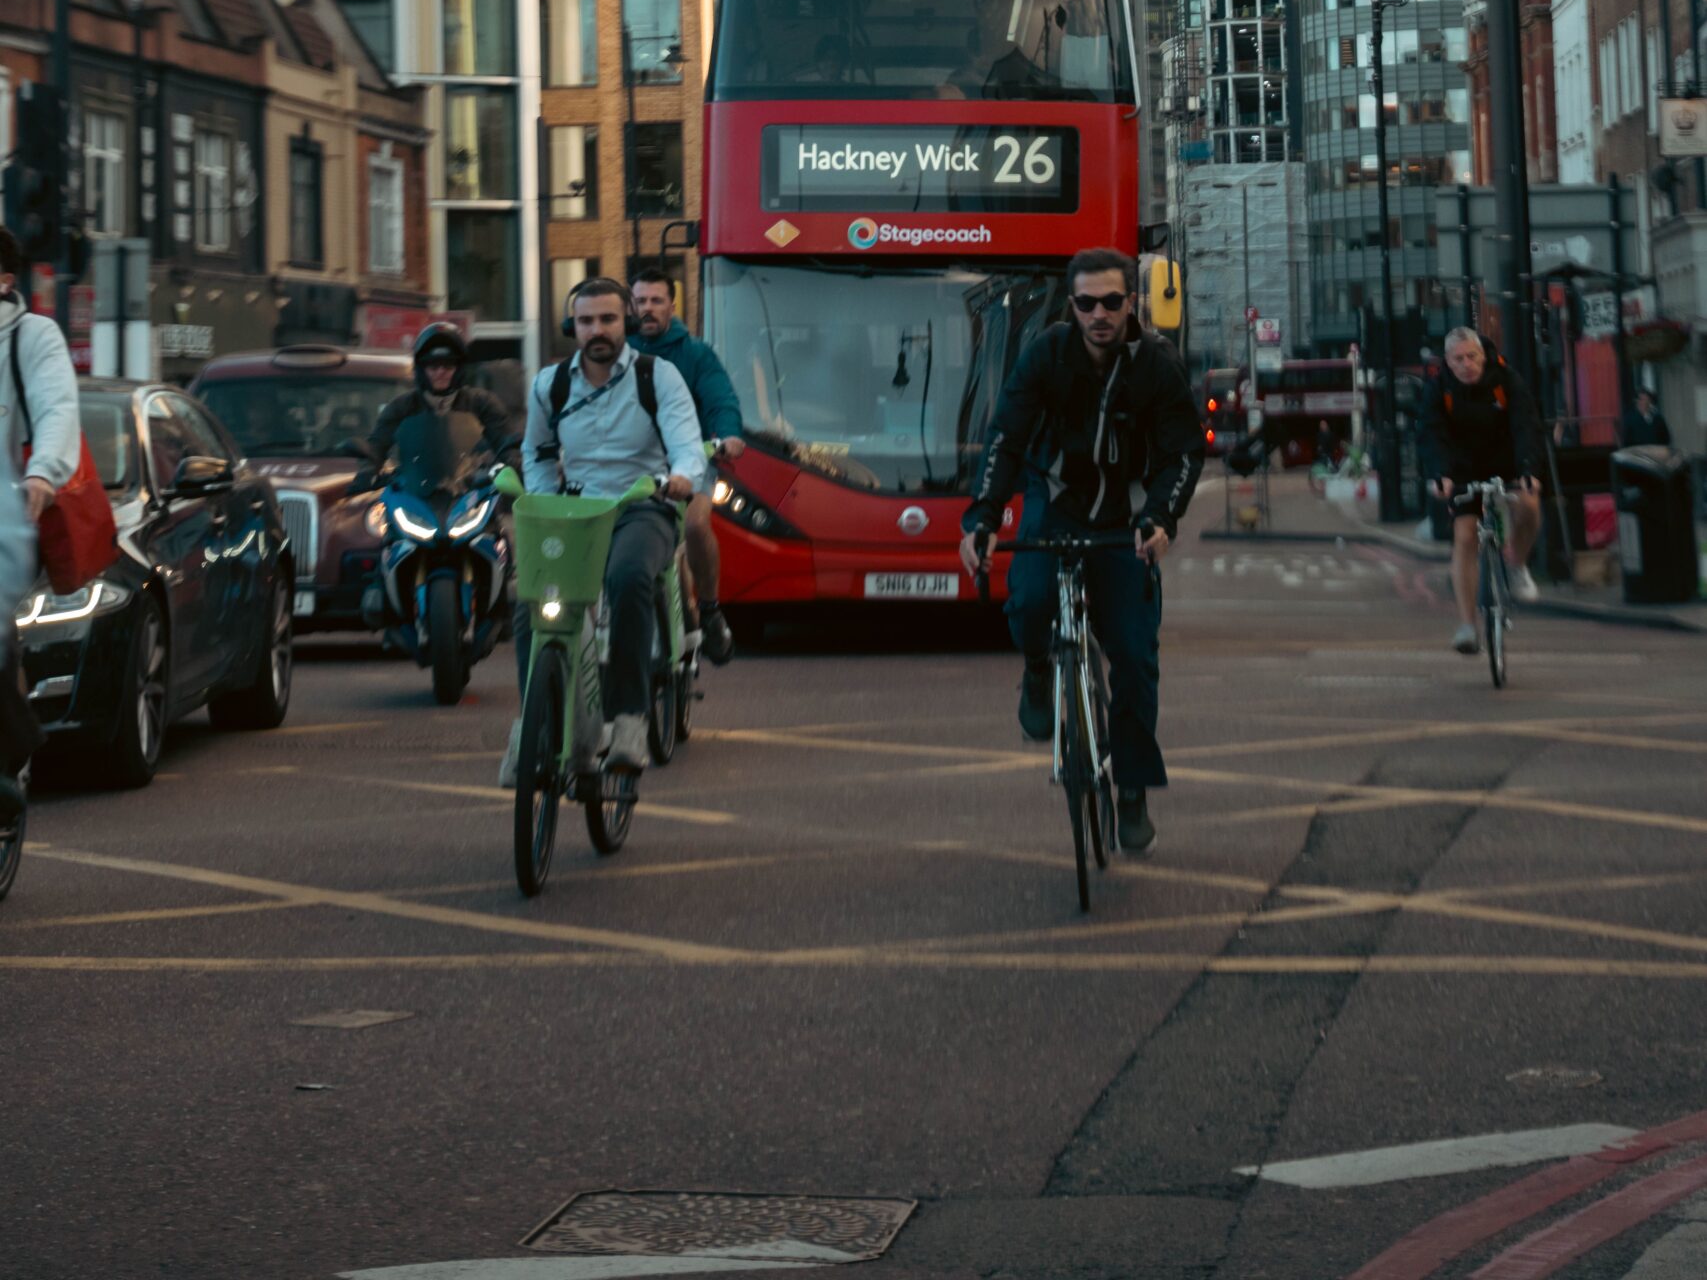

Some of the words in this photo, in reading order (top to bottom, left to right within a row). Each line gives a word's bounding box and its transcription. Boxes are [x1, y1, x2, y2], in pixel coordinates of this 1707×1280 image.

[798, 142, 908, 179] Hackney
[915, 143, 980, 171] Wick
[993, 135, 1056, 184] 26
[879, 223, 992, 246] Stagecoach
